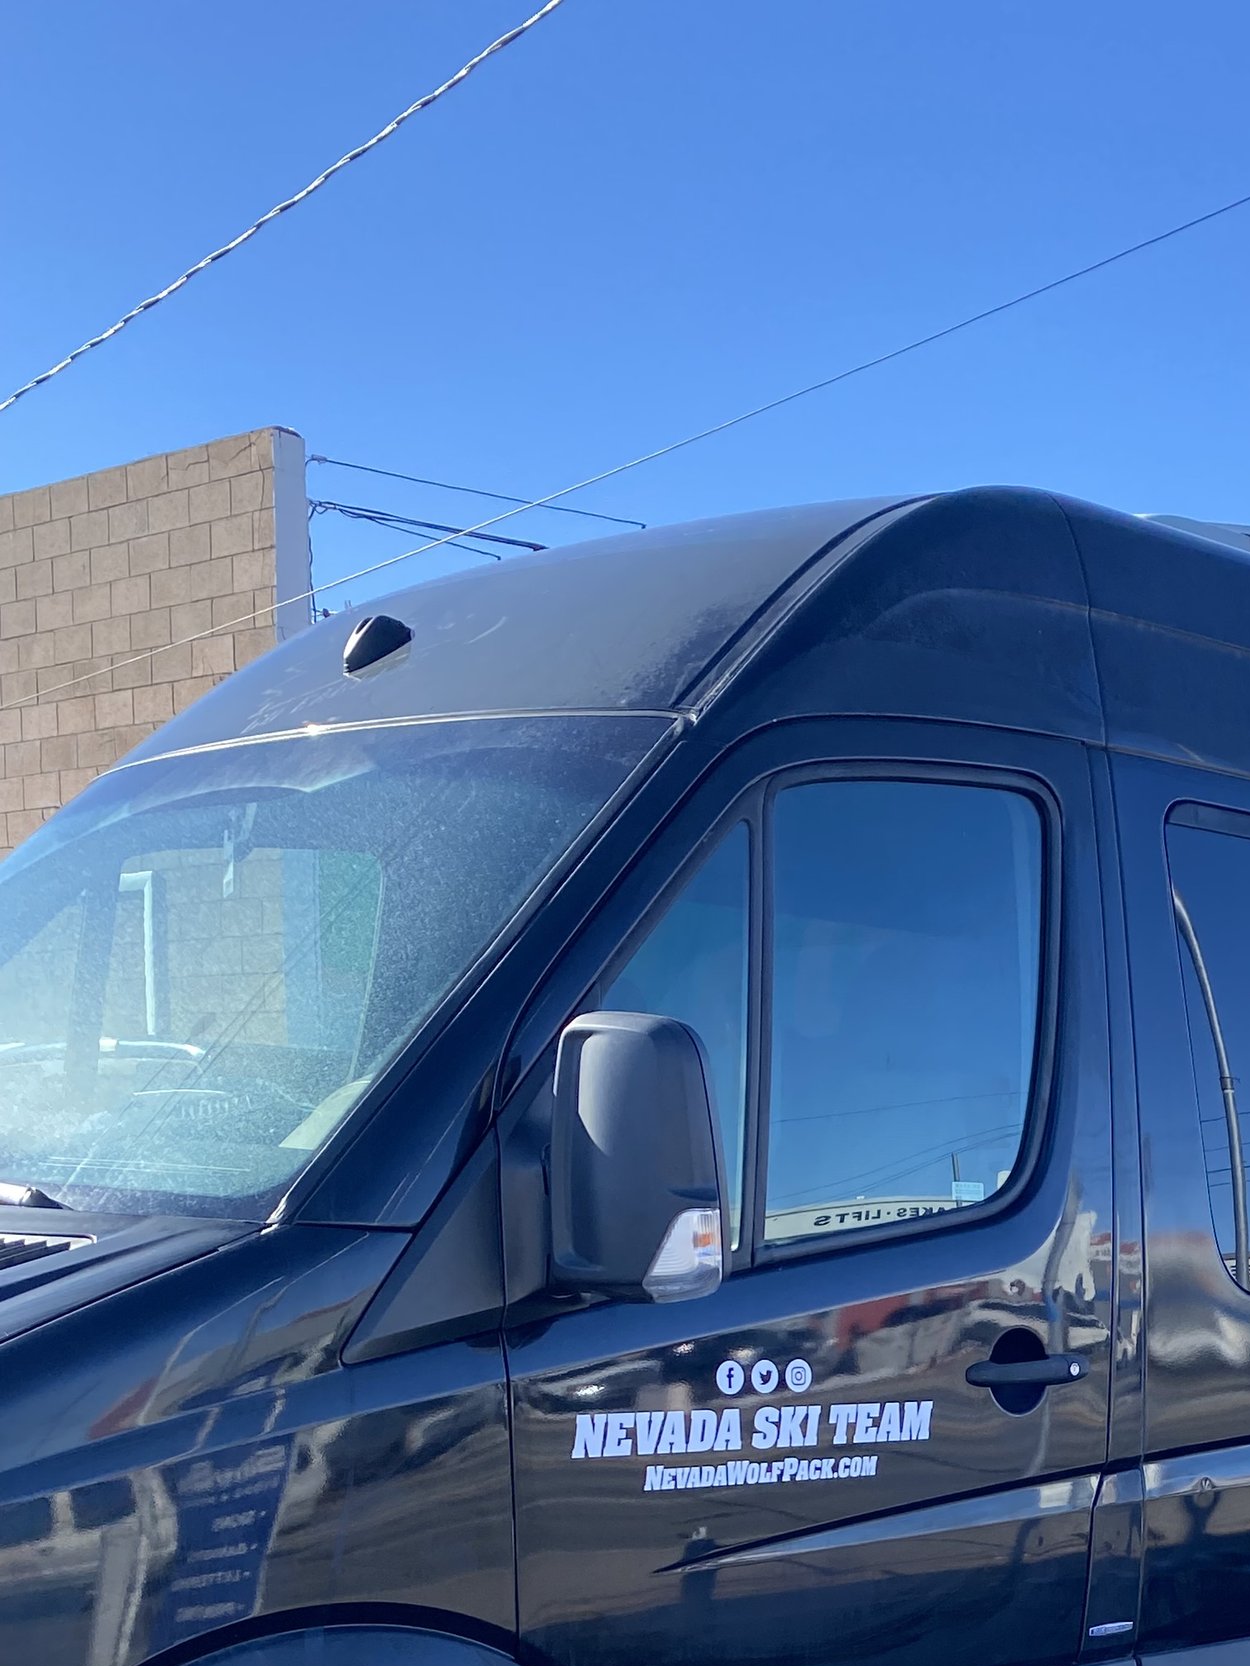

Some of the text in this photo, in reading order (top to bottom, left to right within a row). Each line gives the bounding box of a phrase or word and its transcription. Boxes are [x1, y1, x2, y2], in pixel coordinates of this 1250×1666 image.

[571, 1400, 933, 1459] NEVADA SKI TEAM
